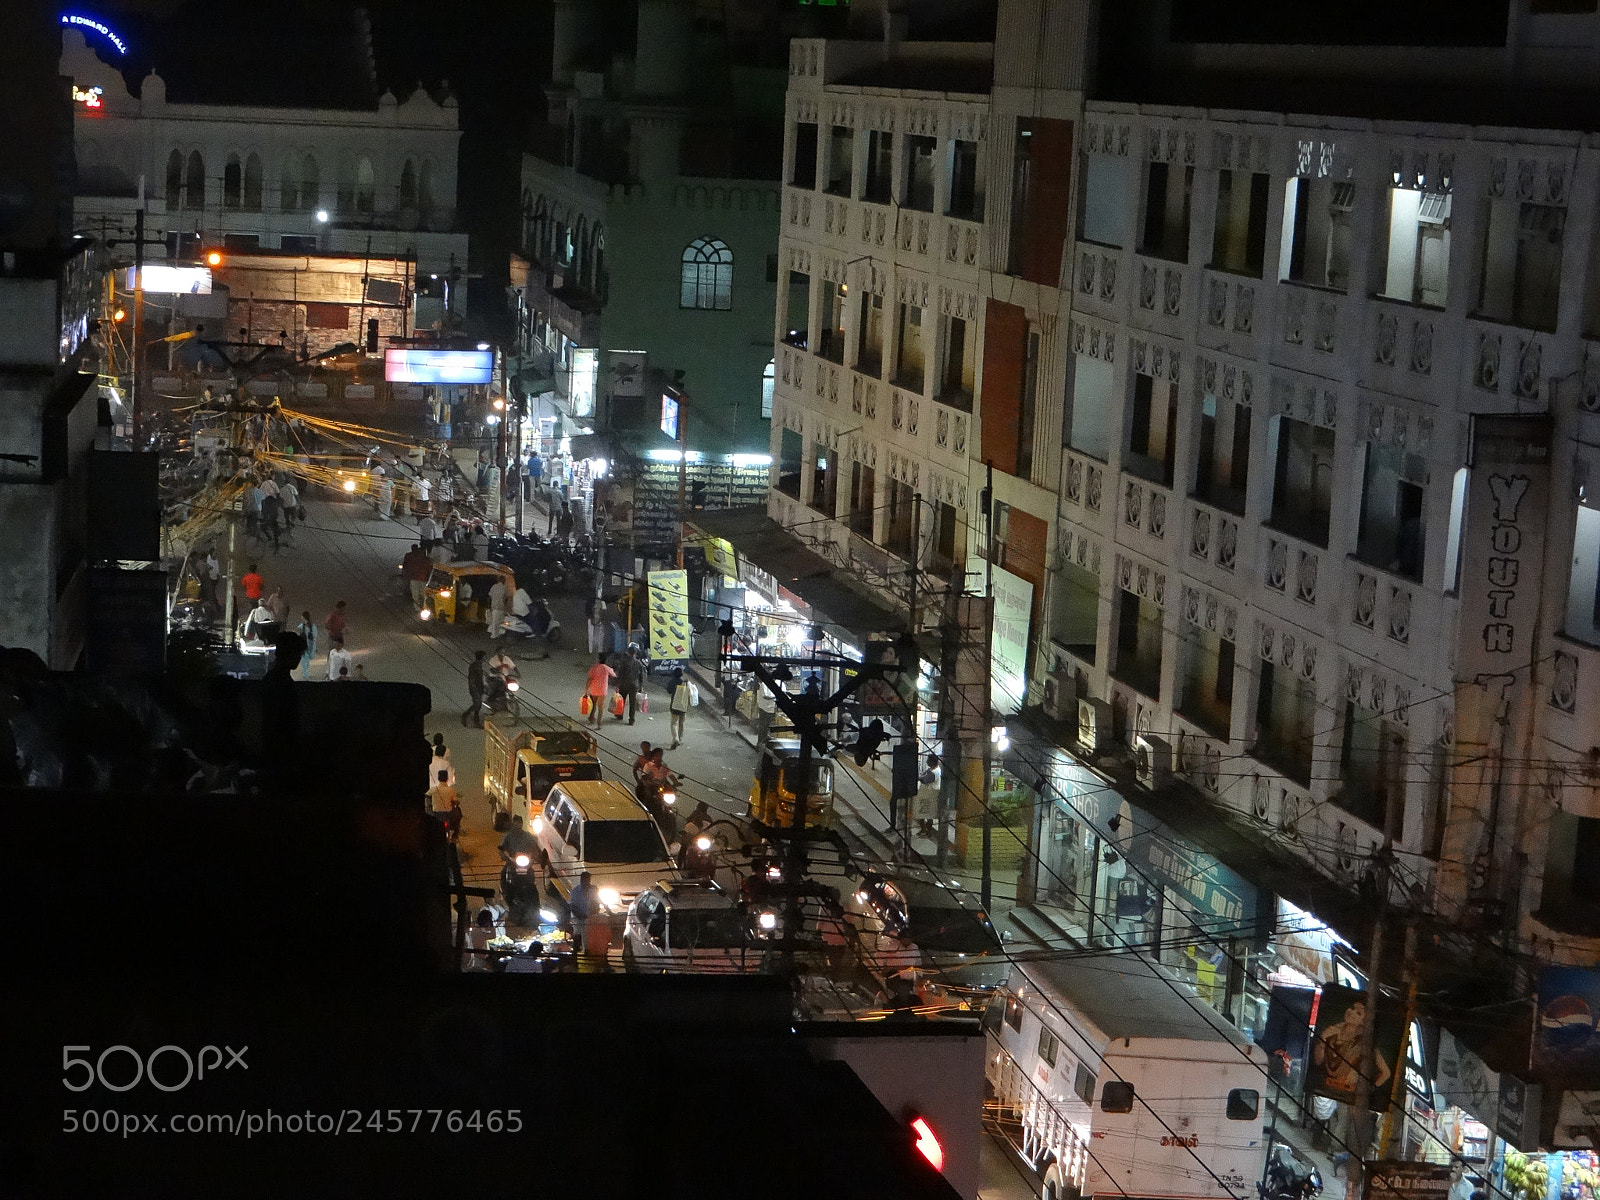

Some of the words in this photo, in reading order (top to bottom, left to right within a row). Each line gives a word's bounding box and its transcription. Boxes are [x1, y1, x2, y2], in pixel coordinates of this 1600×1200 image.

[70, 15, 109, 35] EDWARD
[108, 32, 127, 54] HALL
[1482, 474, 1531, 653] YOUTH
[1072, 787, 1100, 821] SHOP
